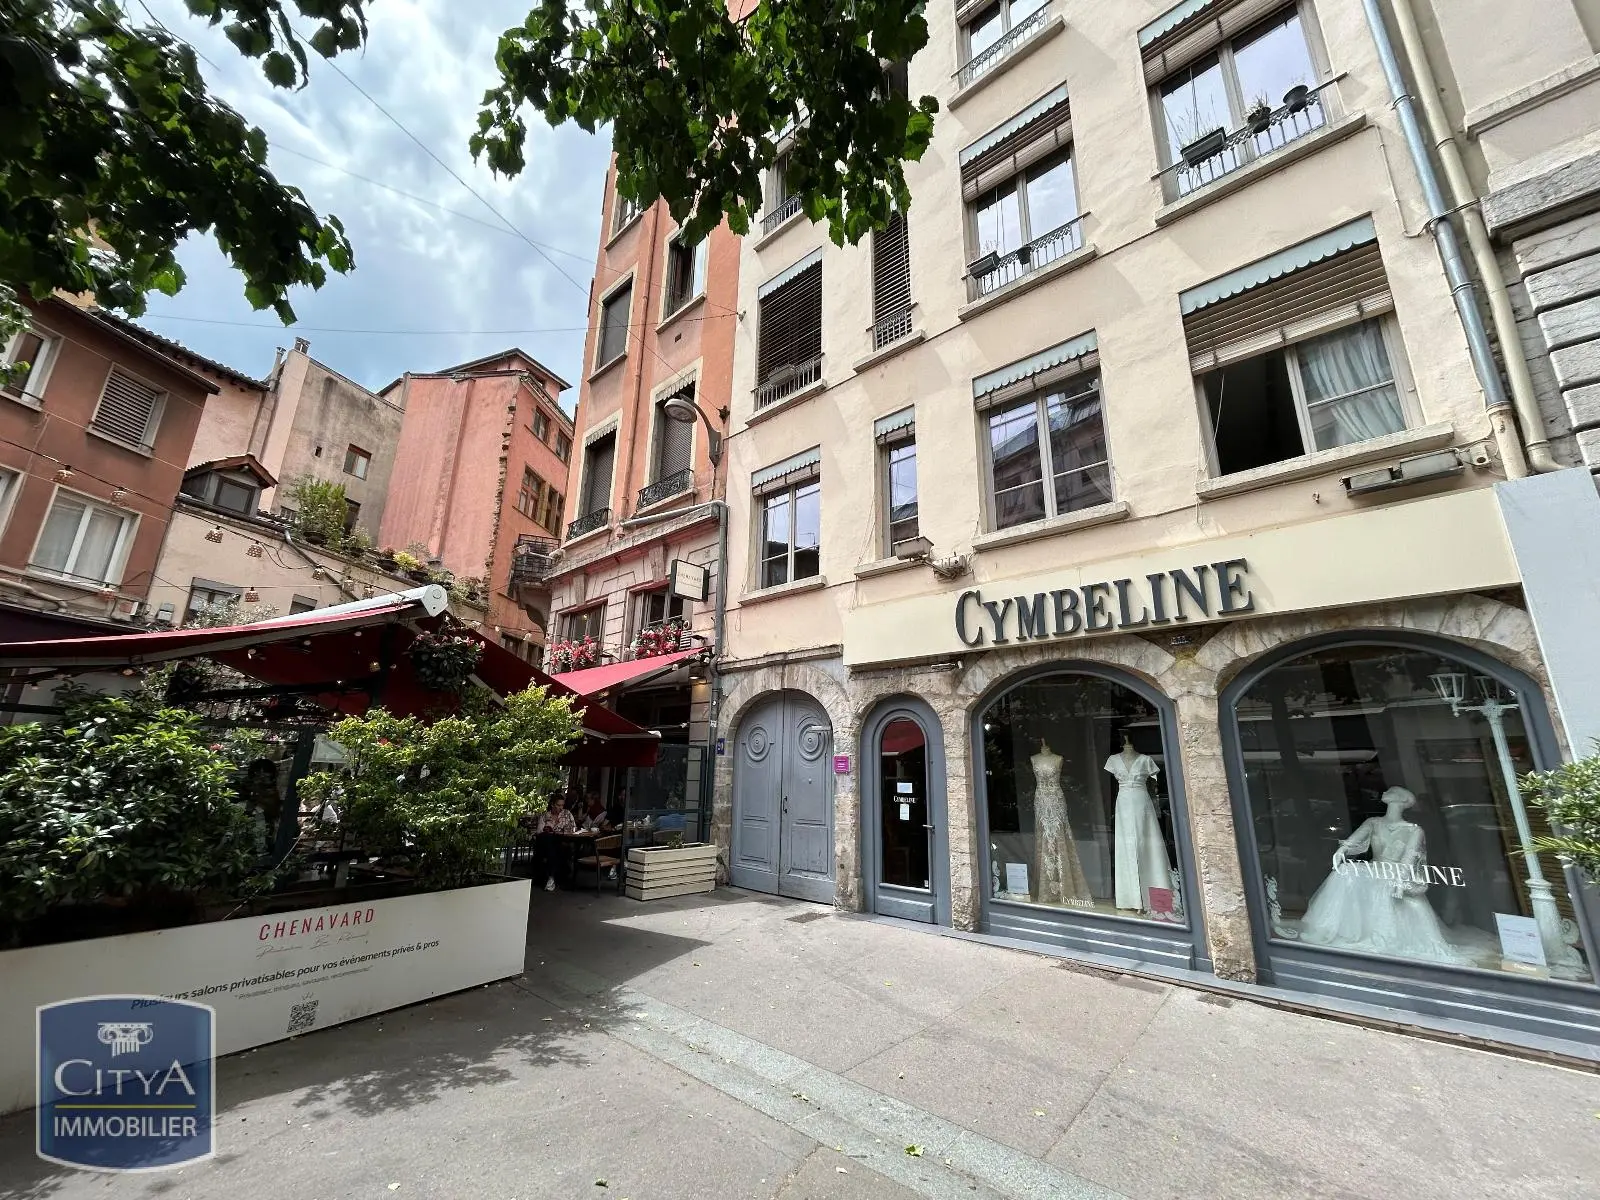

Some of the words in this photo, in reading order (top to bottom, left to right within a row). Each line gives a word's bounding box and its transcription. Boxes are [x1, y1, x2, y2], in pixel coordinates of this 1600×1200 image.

[955, 558, 1255, 647] CYMBELINE
[1332, 852, 1466, 887] CYMBELINE
[259, 908, 375, 941] CHENAVARD
[190, 983, 229, 999] salons
[229, 968, 295, 992] privatisables
[296, 964, 321, 979] pour
[322, 960, 338, 971] vos
[339, 949, 391, 967] événements
[391, 943, 415, 958] privés
[415, 941, 422, 951] &
[422, 938, 440, 952] pros
